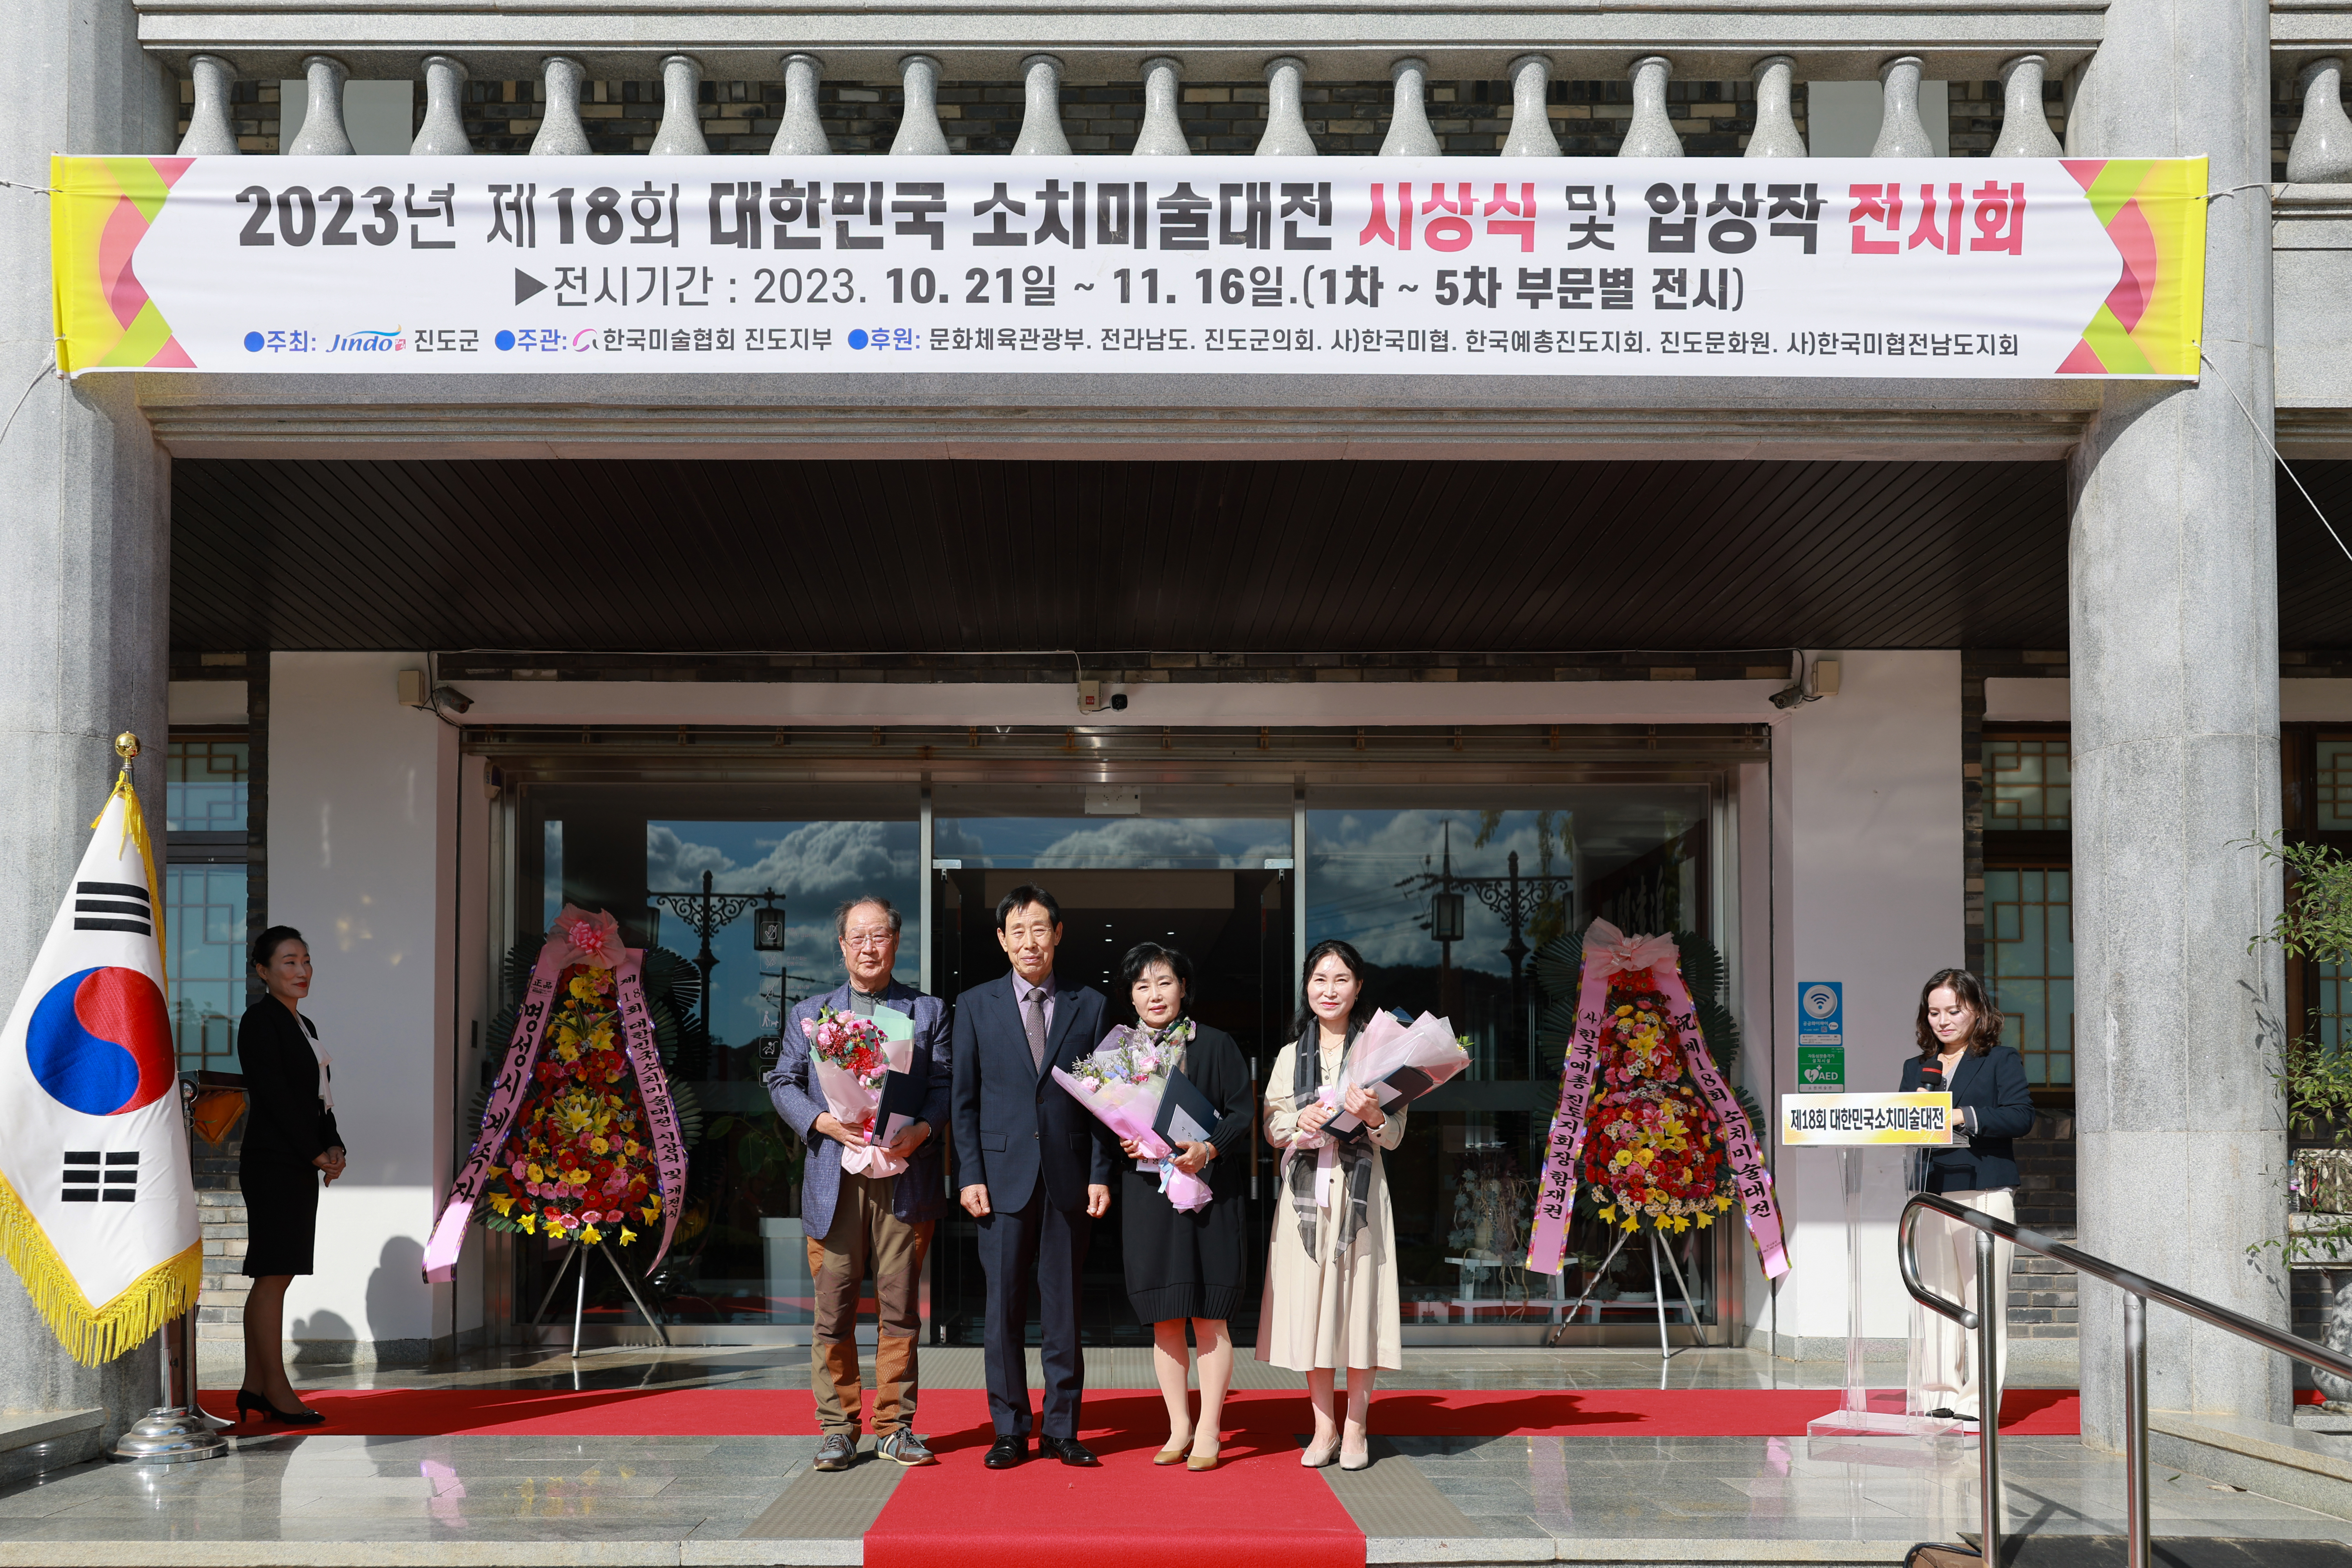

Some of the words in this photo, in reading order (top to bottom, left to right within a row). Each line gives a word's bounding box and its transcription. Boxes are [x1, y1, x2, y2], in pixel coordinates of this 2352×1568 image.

[236, 183, 456, 249] 2023년
[487, 181, 679, 248] 제18회
[709, 179, 947, 250] 대한민국
[973, 179, 1332, 250] 소치미술대전
[1360, 182, 1536, 252] 시상식
[1566, 185, 1615, 250] 및
[1644, 183, 1828, 254] 입상작
[1849, 181, 2026, 255] 전시회
[555, 267, 713, 306] 전시기간
[755, 268, 865, 303] 2023.
[887, 268, 948, 303] 10.
[965, 266, 1055, 306] 21일
[1114, 269, 1175, 303] 11.
[1436, 266, 1502, 308] 5차
[1517, 268, 1633, 309] 부문별
[1653, 267, 1743, 311] 전시)
[267, 330, 315, 352] 주최:
[326, 334, 392, 352] Jindo
[415, 330, 479, 352] 진도군
[518, 329, 566, 351] 주관:
[604, 328, 734, 351] 한국미술협회
[746, 328, 831, 350] 진도지부
[871, 328, 920, 350] 후원:
[930, 328, 1091, 350] 문화체육관광부.
[1102, 328, 1194, 350] 전라남도.
[1205, 328, 1321, 351] 진도군의회.
[1331, 328, 1456, 352] 사)한국미협.
[1466, 330, 1650, 353] 한국예총진도지회.
[1661, 331, 1777, 354] 진도문화원.
[1787, 332, 2017, 356] 사)한국미협전남도지회
[532, 979, 552, 989] 正品
[628, 1018, 671, 1127] 대한민국소치미술대전
[1550, 1093, 1586, 1166] 진도지회장
[1674, 1013, 1697, 1033] 祝
[1724, 1110, 1771, 1218] 소치미술대전
[1791, 1108, 1826, 1131] 제18회
[1830, 1107, 1944, 1131] 대한민국소치미술대전
[655, 1131, 681, 1164] 시상식
[662, 1168, 681, 1180] 및
[1543, 1170, 1573, 1220] 함재권
